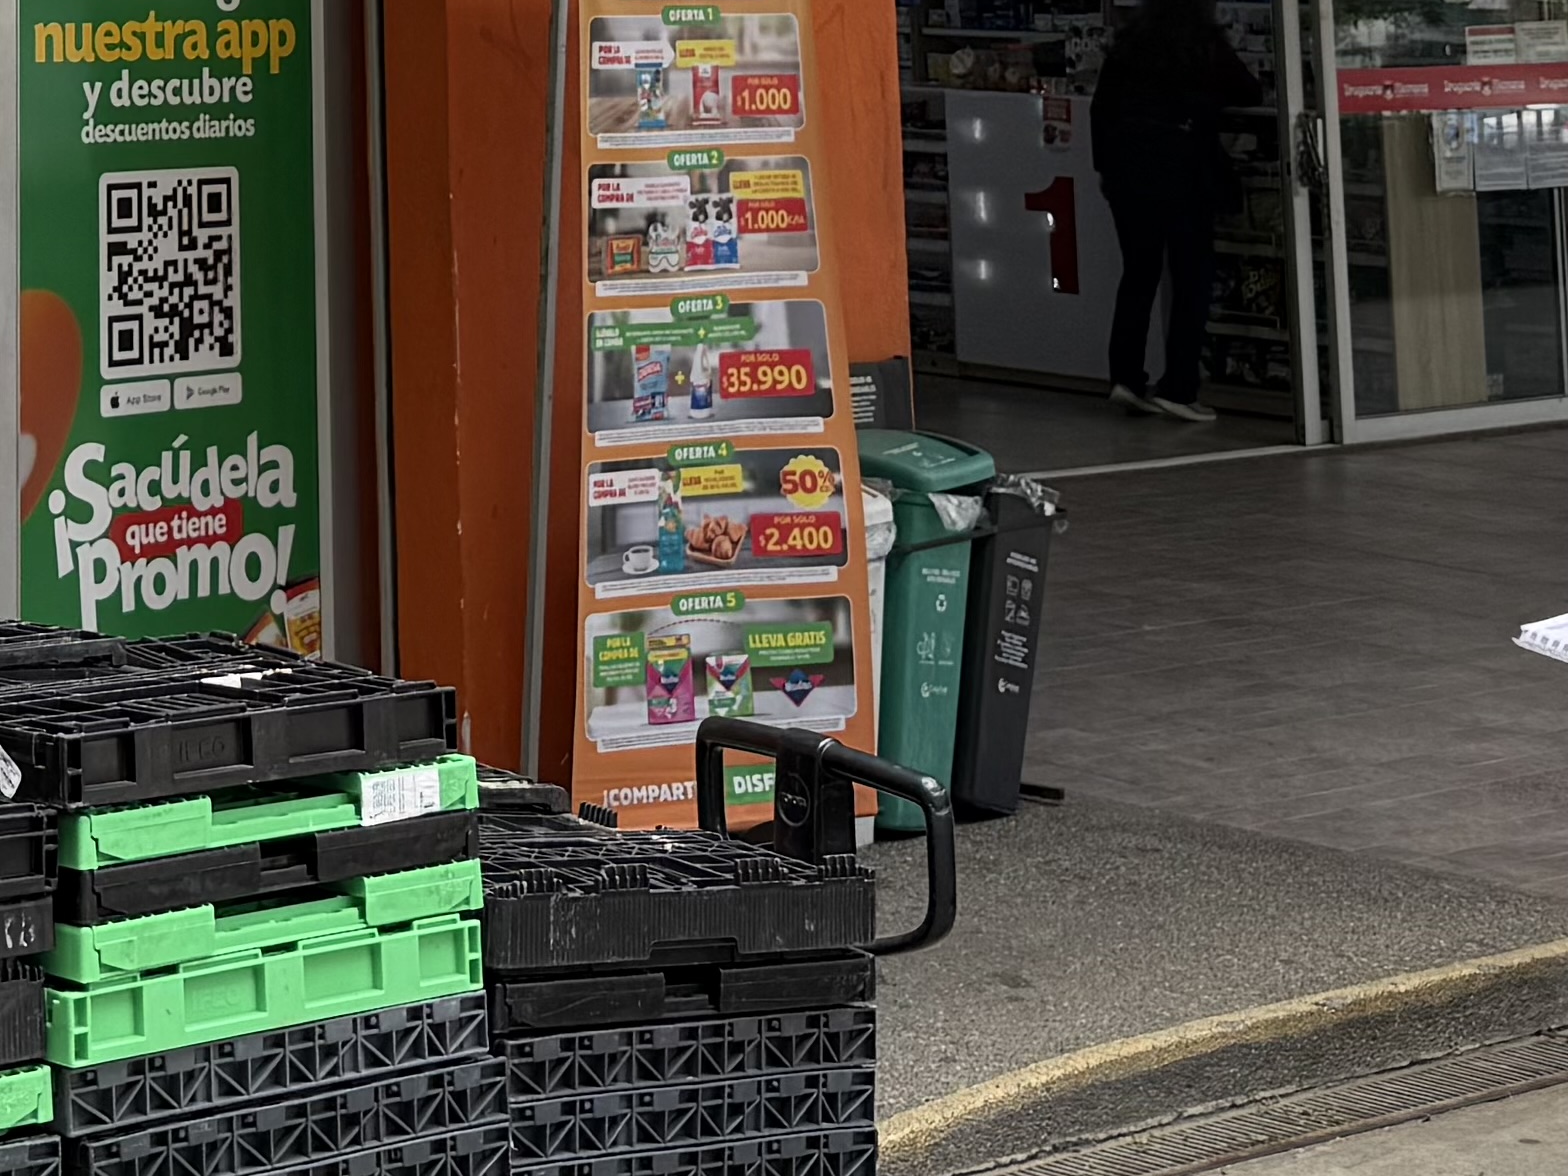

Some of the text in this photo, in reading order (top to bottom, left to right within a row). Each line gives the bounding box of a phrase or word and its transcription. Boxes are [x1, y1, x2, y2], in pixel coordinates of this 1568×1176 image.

[669, 8, 713, 21] OFERTA 1
[34, 10, 296, 74] nuestra app
[82, 67, 253, 120] y descubre
[81, 113, 255, 145] descuentos diarios
[673, 150, 718, 167] OFERTA 2
[1024, 176, 1079, 295] 1
[678, 296, 723, 314] OFERTA 3
[722, 364, 807, 394] $35.990
[674, 443, 727, 461] OFERTA 4
[782, 469, 835, 495] 50%
[48, 430, 297, 578] ¡Sacúdela
[126, 511, 226, 554] que tiene
[759, 525, 833, 551] $2.400
[76, 524, 295, 632] Promo!
[679, 592, 736, 611] OFERTA 5
[749, 633, 785, 648] LLEVA
[787, 631, 826, 647] GRATIS
[604, 780, 696, 808] ¡COMPART
